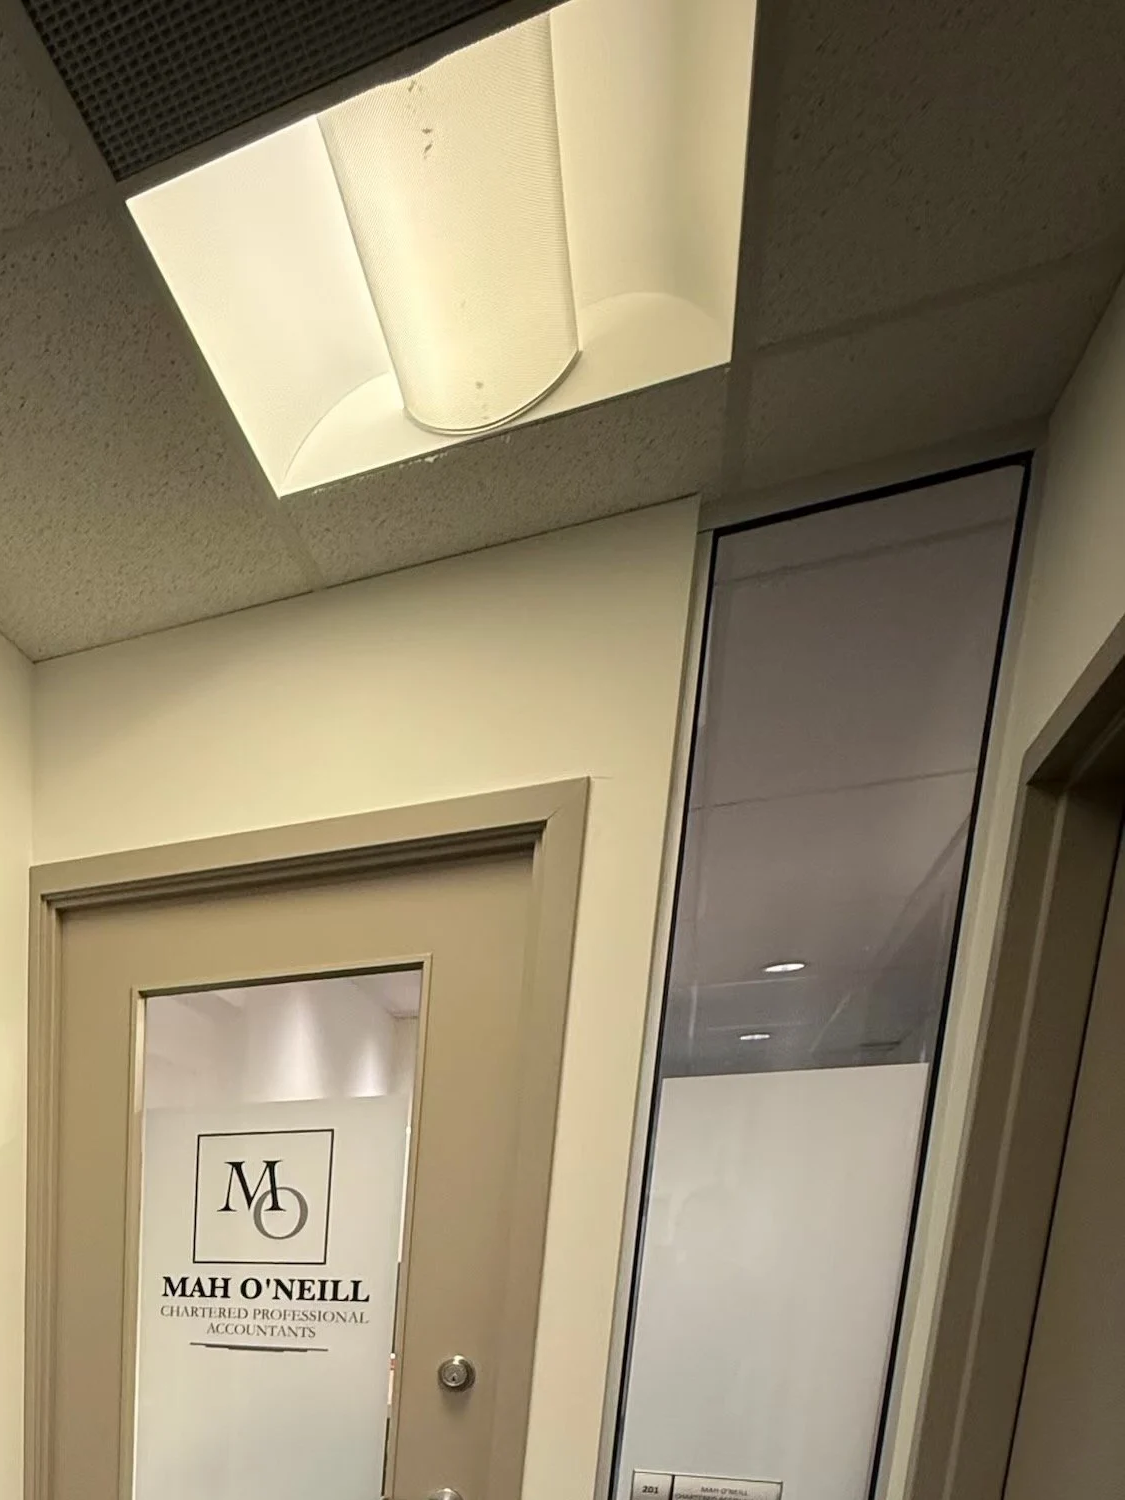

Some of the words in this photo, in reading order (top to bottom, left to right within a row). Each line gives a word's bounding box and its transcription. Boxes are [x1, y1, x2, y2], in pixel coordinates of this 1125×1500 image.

[161, 1276, 232, 1299] MAH
[239, 1277, 371, 1302] O'NEILL
[160, 1304, 248, 1320] CHARTERED
[253, 1307, 370, 1324] PROFESSIONAL
[206, 1322, 316, 1339] ACCOUNTANTS
[642, 1485, 659, 1495] 201
